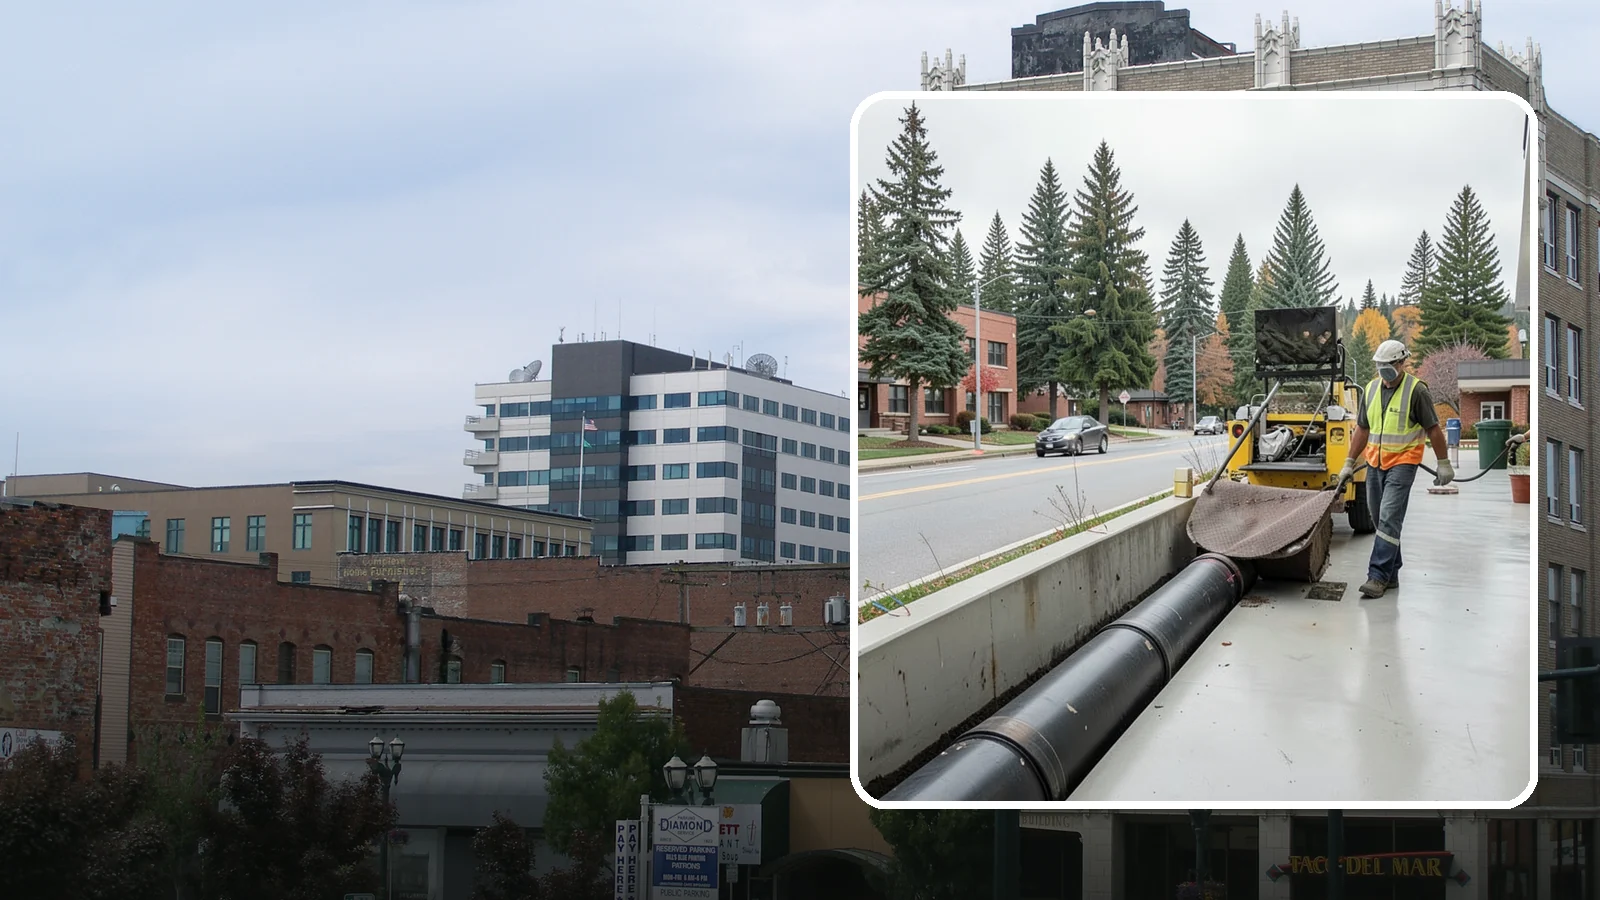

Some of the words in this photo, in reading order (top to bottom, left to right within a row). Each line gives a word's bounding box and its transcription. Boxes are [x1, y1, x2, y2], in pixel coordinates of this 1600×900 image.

[370, 567, 427, 576] Furnishers
[660, 818, 713, 833] DIAMOND
[1022, 815, 1070, 828] BUILDING
[617, 825, 625, 853] PAY
[628, 824, 637, 853] PAY
[721, 852, 739, 863] Soup
[671, 862, 701, 870] PATRONS
[1346, 856, 1385, 876] DEL
[1392, 857, 1443, 877] MAR
[616, 856, 625, 894] HERE
[627, 856, 636, 894] HERE
[660, 888, 682, 897] PUBLIC
[684, 890, 710, 899] PARKING
